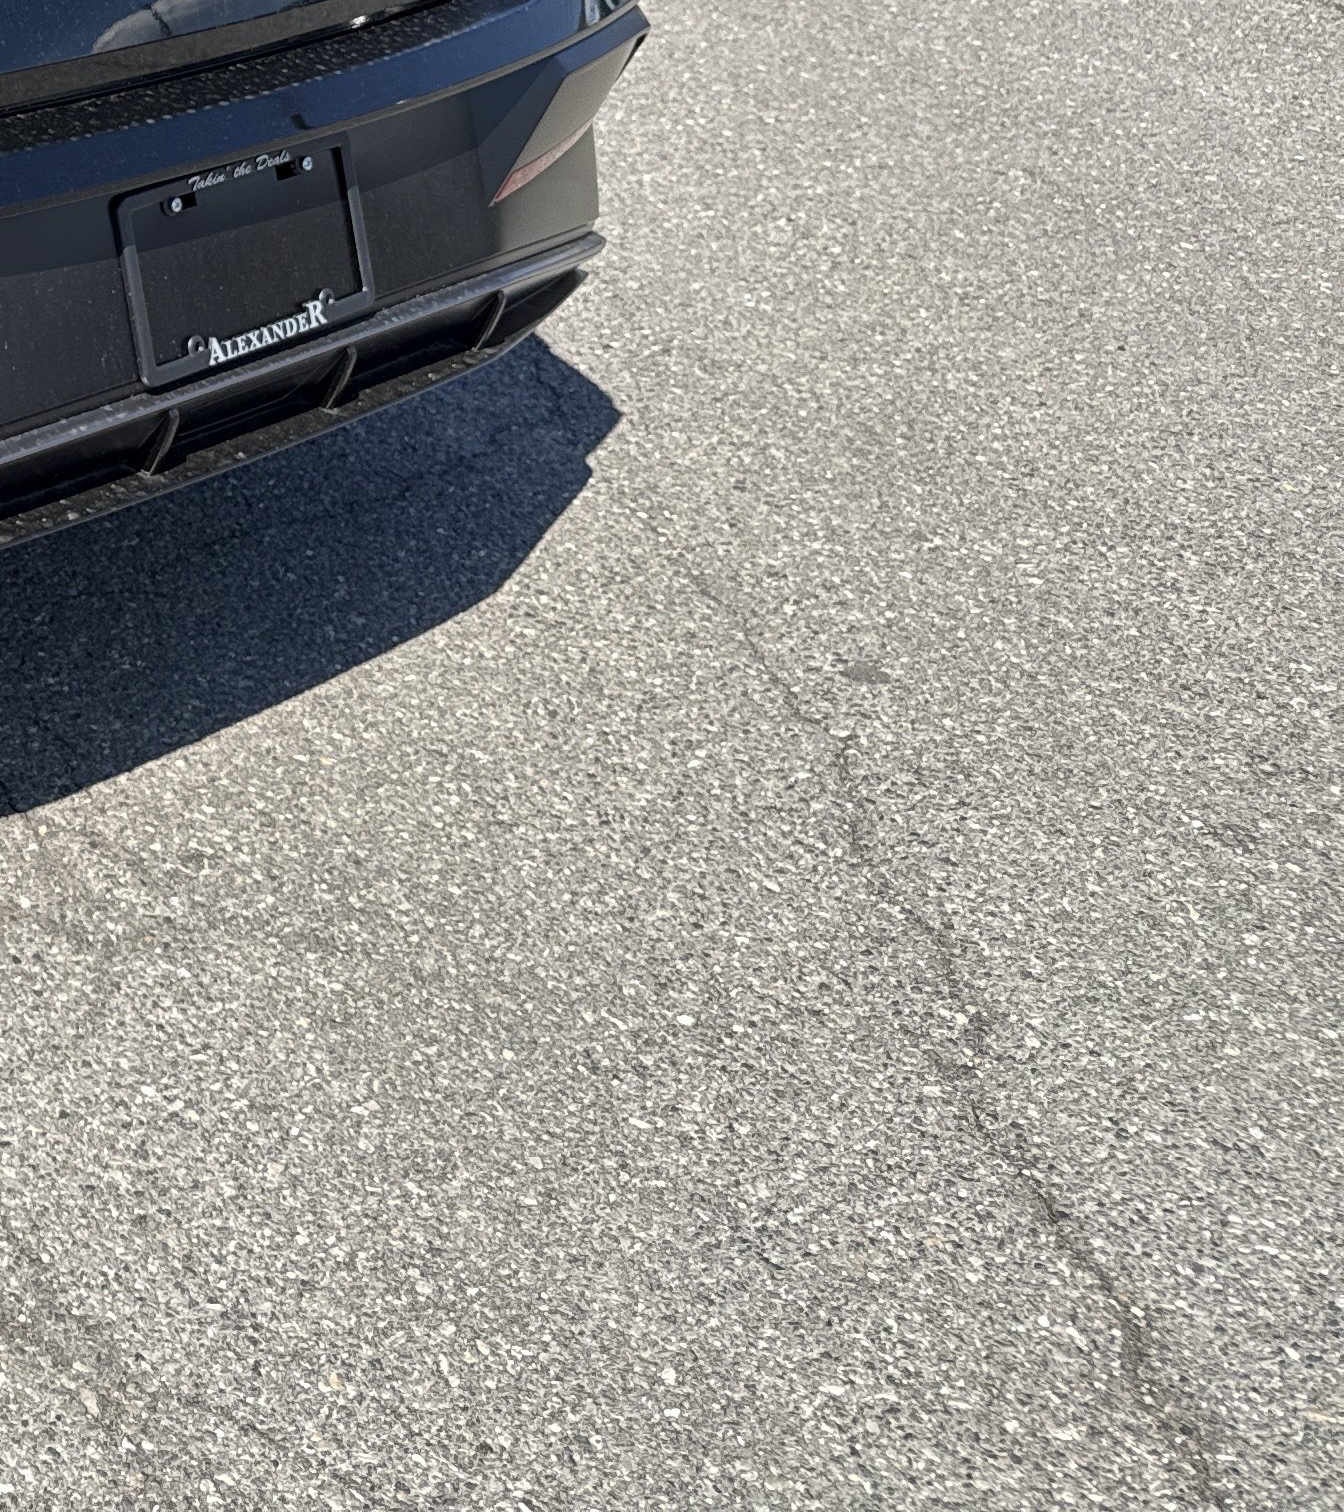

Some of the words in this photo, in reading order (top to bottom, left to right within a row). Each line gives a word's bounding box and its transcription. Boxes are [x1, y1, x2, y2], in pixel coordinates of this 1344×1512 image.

[187, 165, 230, 192] Takin'
[233, 161, 251, 178] the
[255, 148, 291, 171] Deals
[208, 299, 329, 367] ALEXANDER
